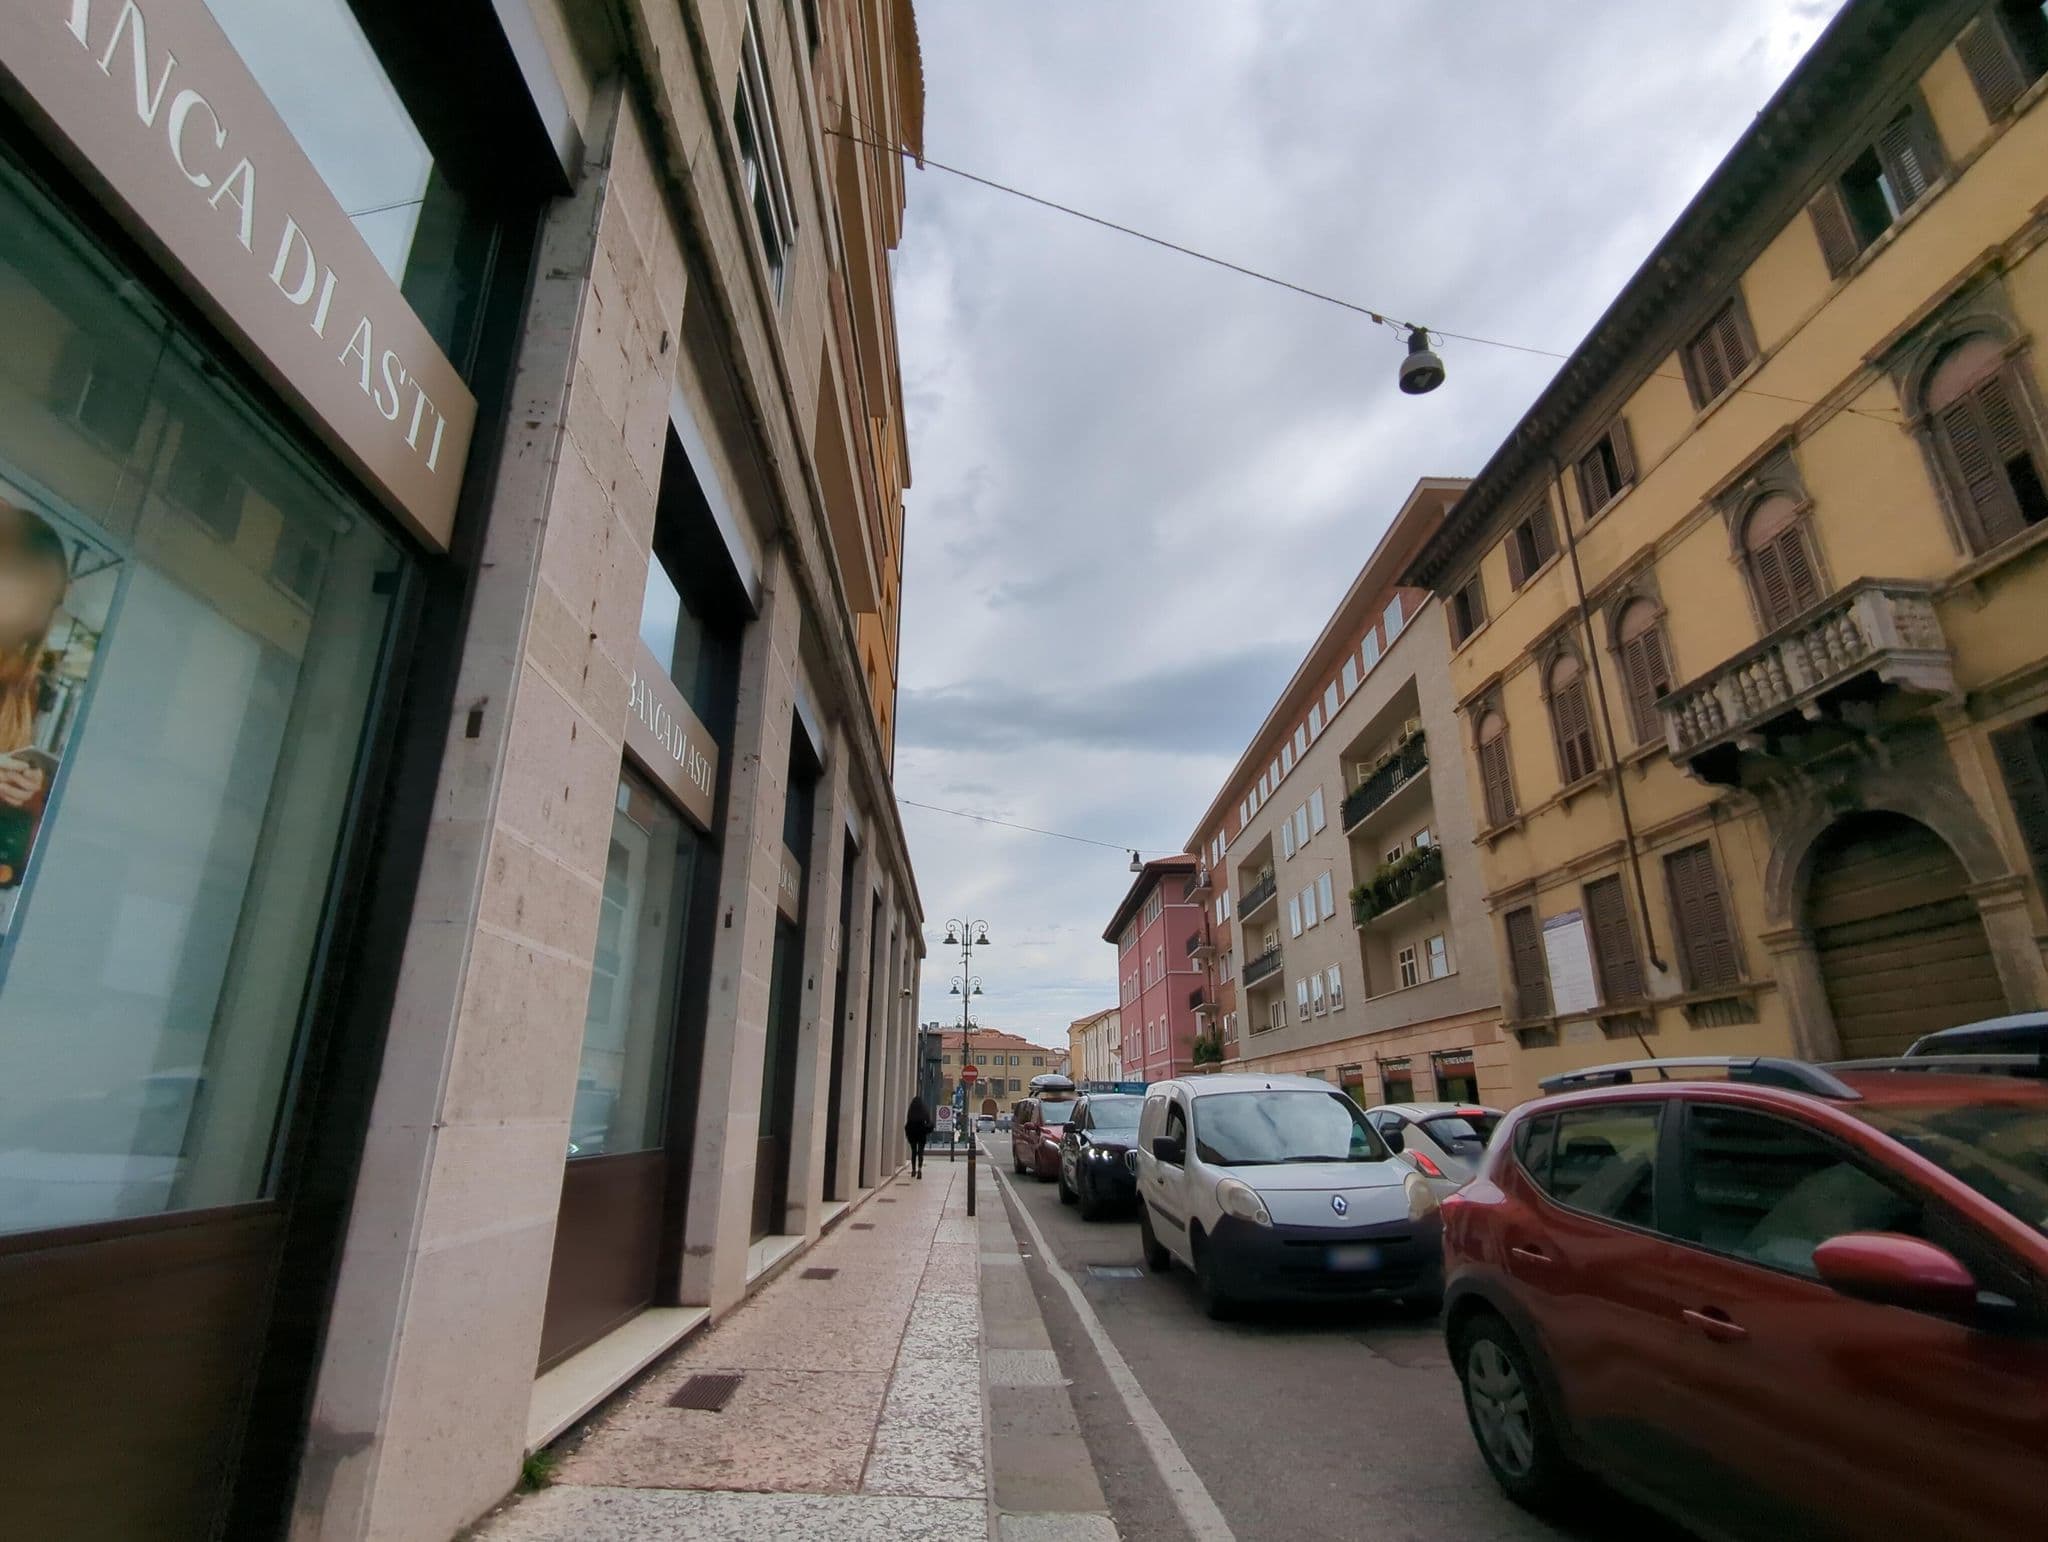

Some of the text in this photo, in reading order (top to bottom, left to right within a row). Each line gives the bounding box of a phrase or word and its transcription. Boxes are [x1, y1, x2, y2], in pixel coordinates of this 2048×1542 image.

[268, 213, 338, 340] DI
[337, 316, 447, 474] ASTI
[673, 724, 687, 768] DI
[686, 744, 712, 797] ASTI
